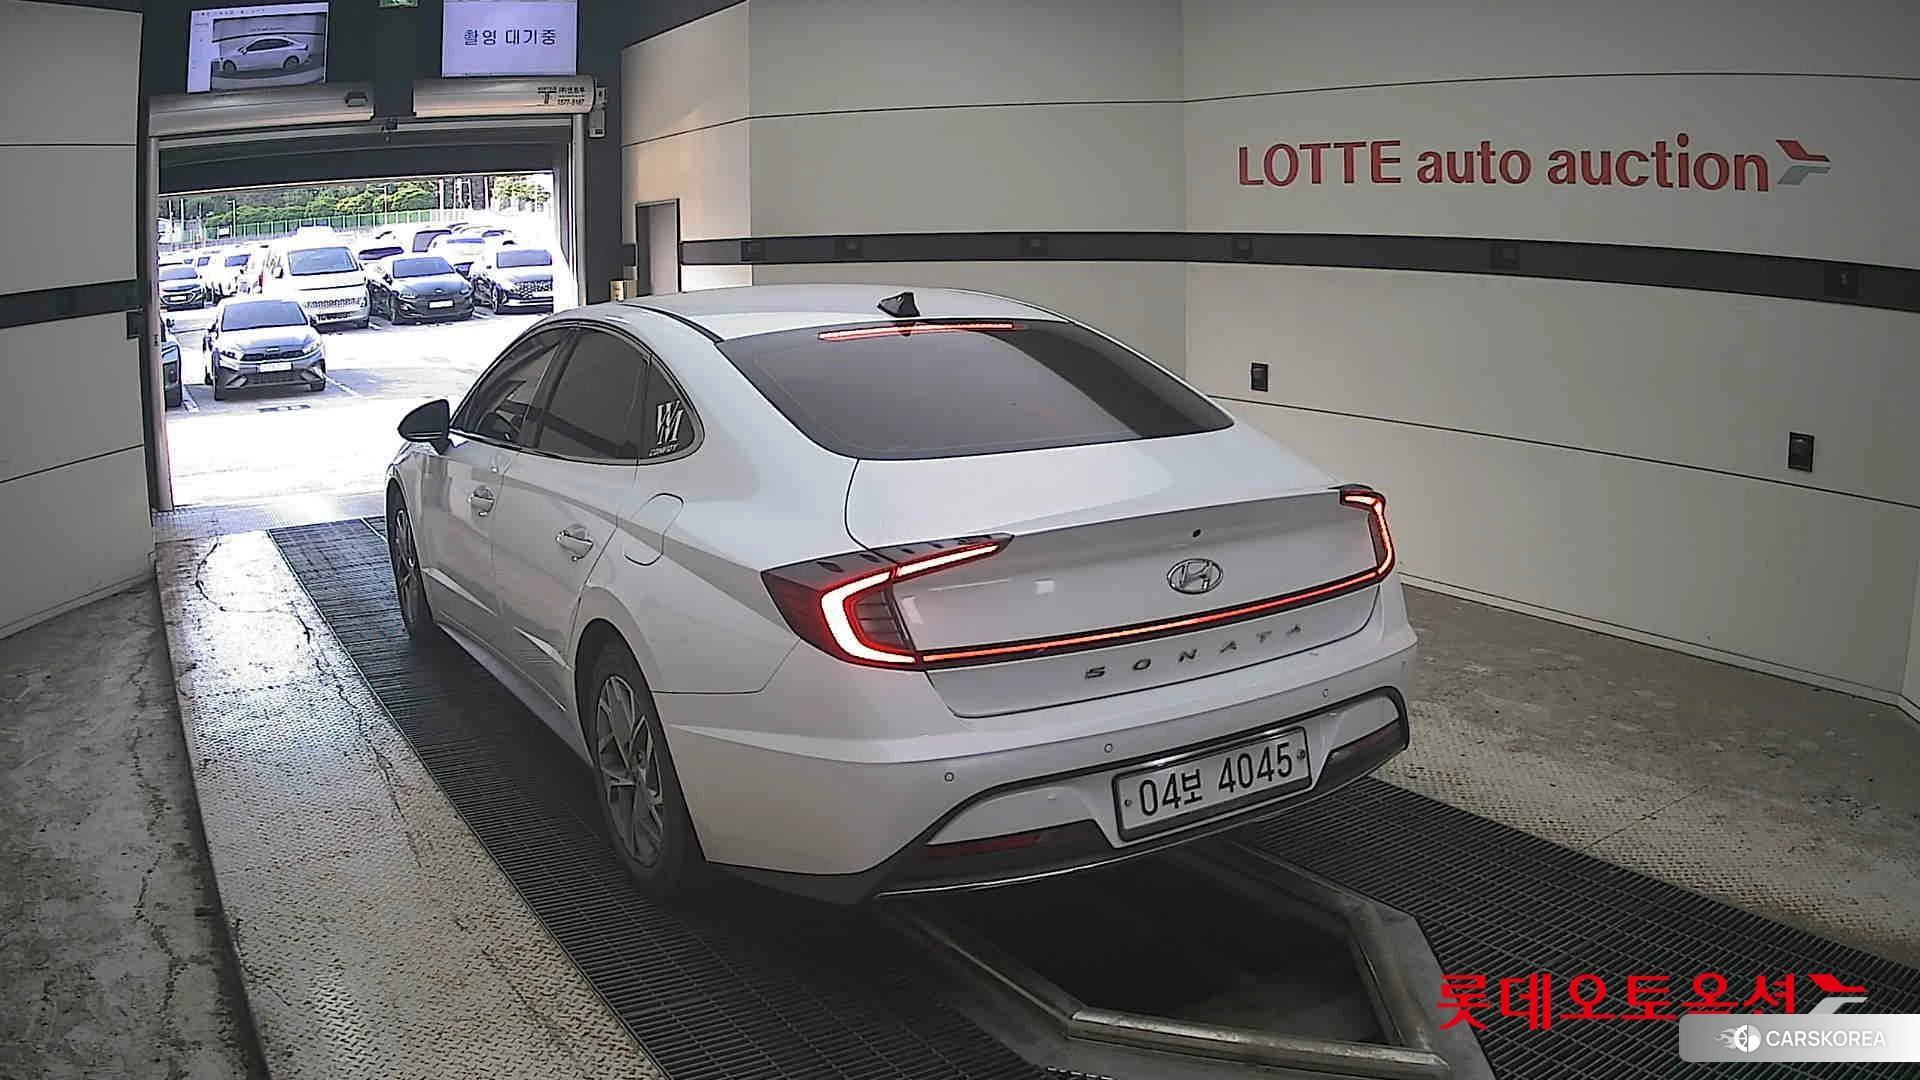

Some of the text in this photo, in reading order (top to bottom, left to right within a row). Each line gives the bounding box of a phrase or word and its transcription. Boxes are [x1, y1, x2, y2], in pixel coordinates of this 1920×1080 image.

[505, 29, 556, 46] 대기중
[1239, 133, 1770, 191] LOTTE auto auction
[1084, 623, 1303, 681] SONATA
[1138, 741, 1294, 816] 04보 4045
